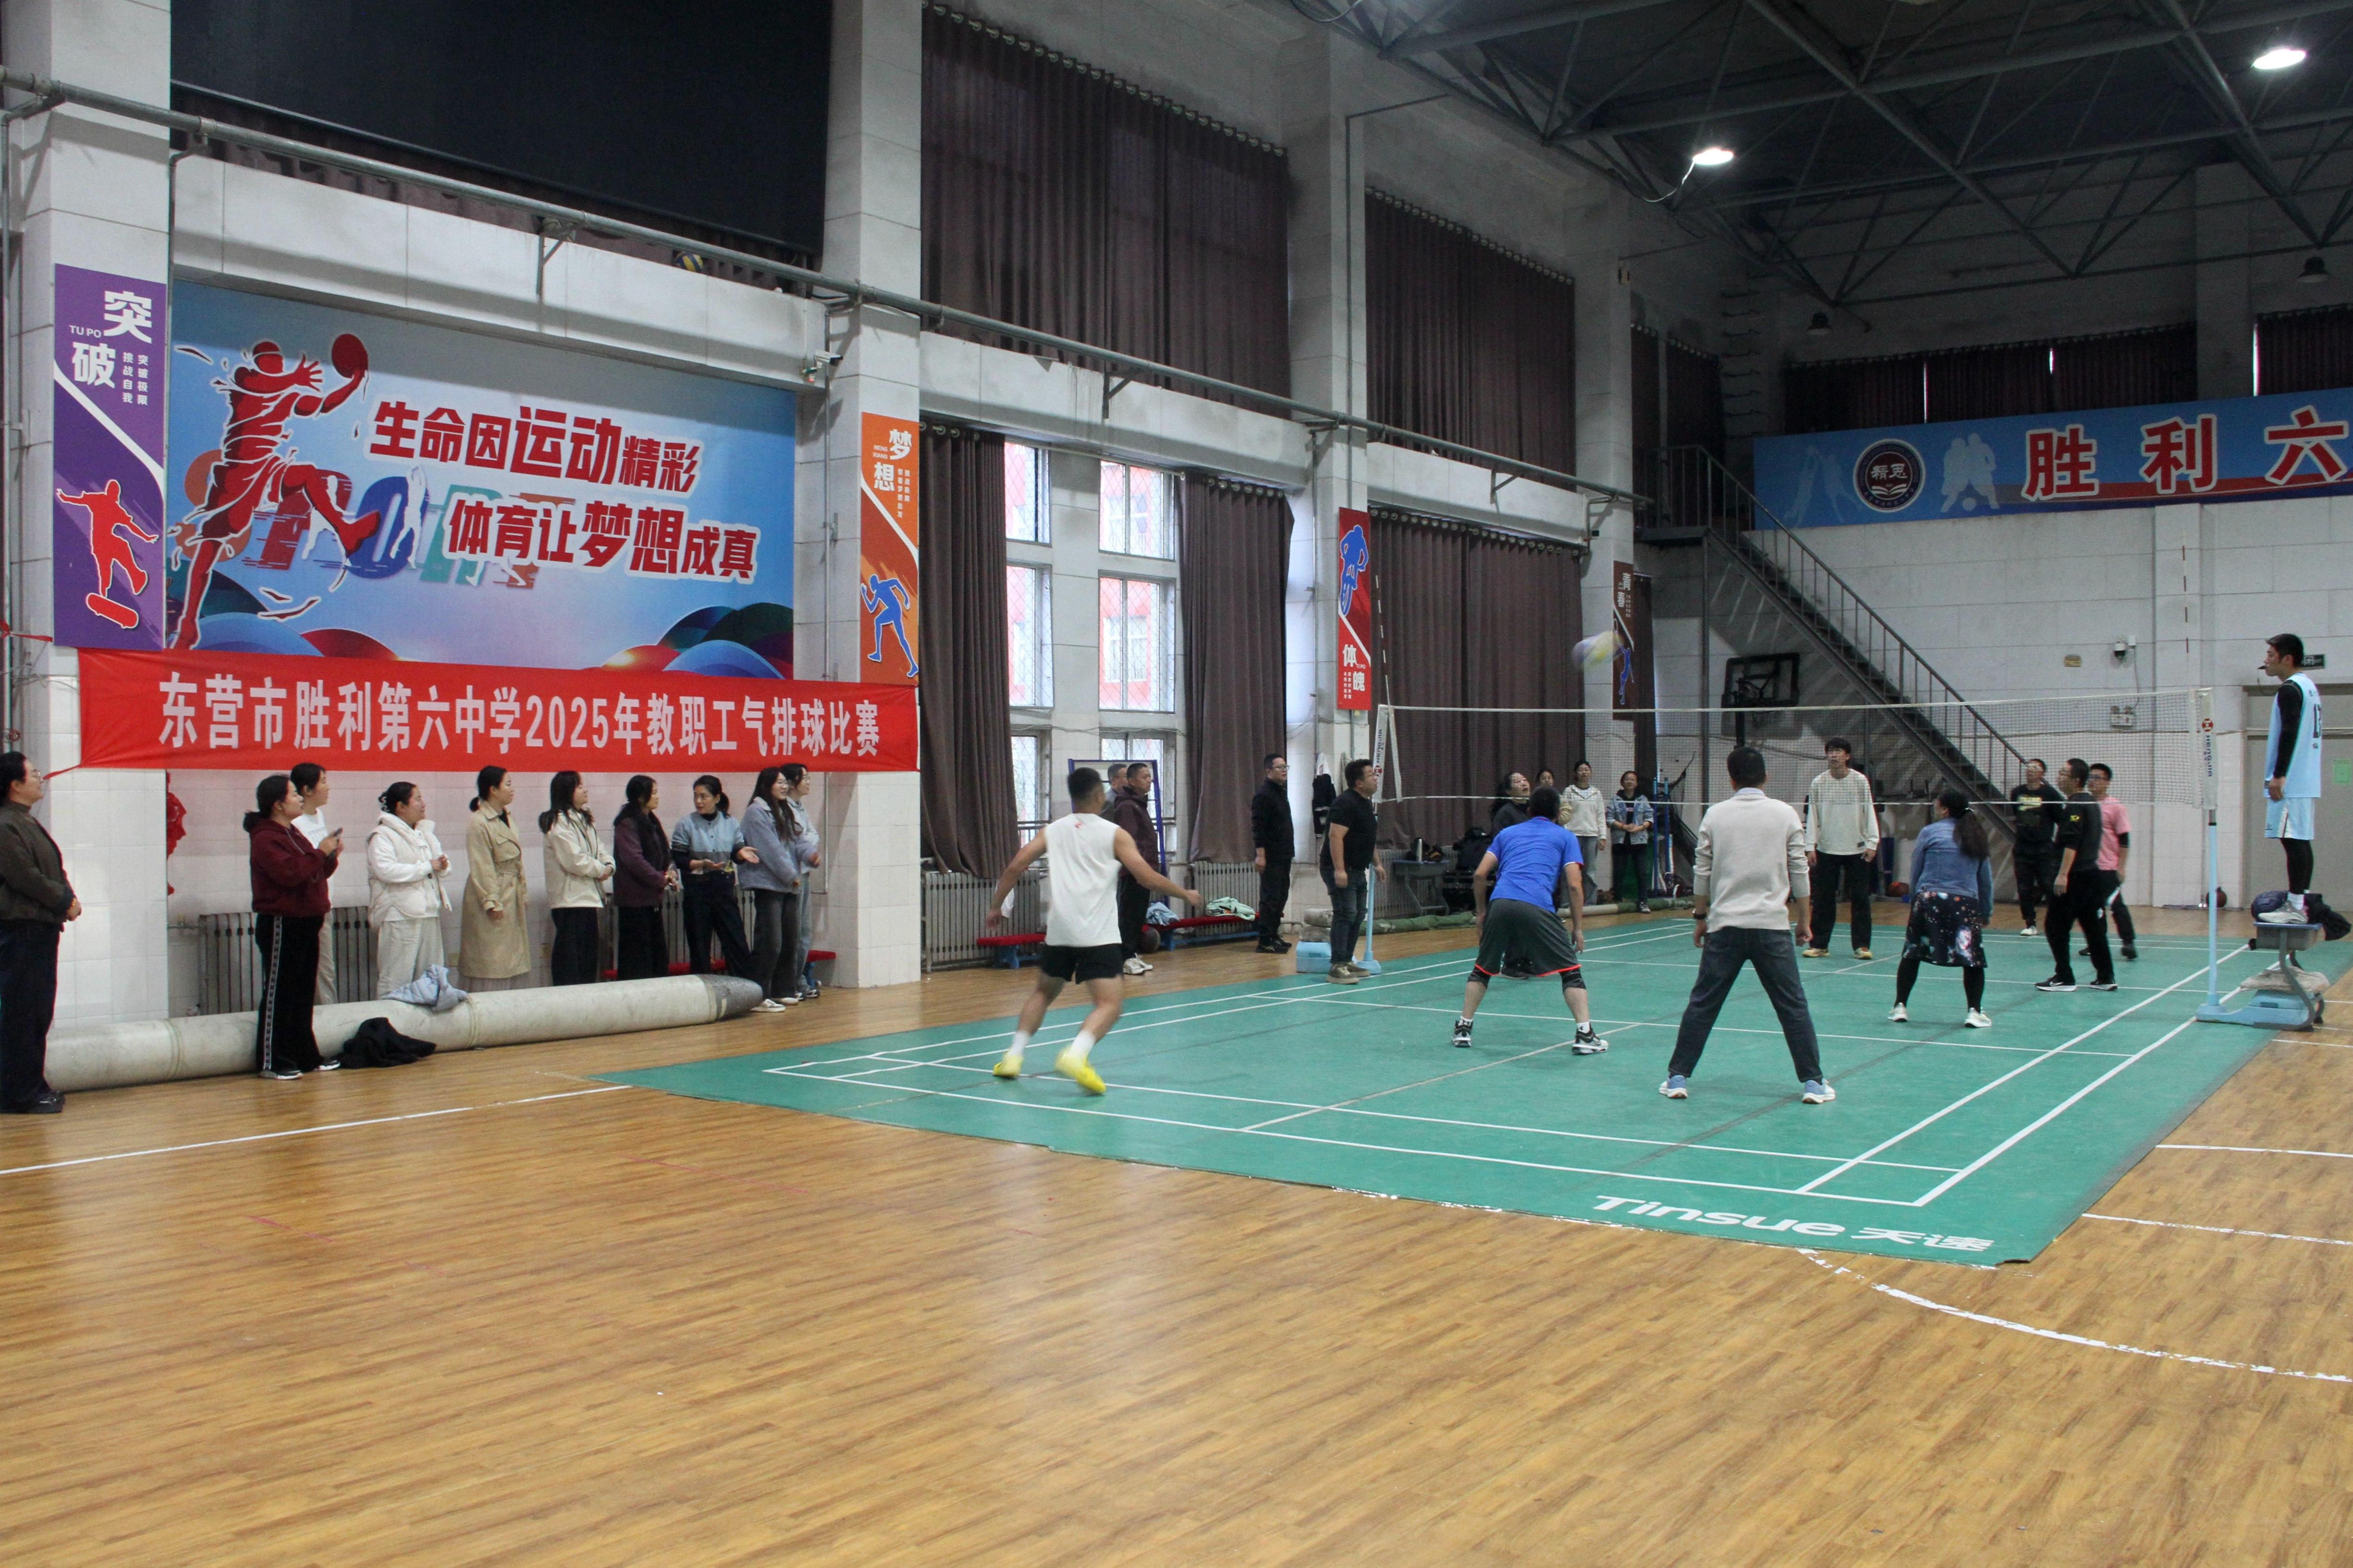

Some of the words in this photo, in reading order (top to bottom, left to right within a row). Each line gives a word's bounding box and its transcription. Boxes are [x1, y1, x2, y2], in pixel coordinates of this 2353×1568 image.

[69, 325, 84, 335] TU
[87, 328, 102, 338] PO
[103, 291, 152, 344] 突
[72, 342, 116, 389] 破
[123, 352, 133, 404] 挑战自我
[137, 354, 148, 406] 突破极限
[370, 401, 701, 493] 生命因运动精彩
[889, 429, 912, 460] 梦
[2025, 408, 2348, 498] 胜利六
[874, 462, 894, 491] 想
[448, 498, 758, 579] 体育让梦想成真
[1342, 644, 1357, 667] 体
[1353, 671, 1365, 691] 魄
[159, 671, 880, 756] 东营市胜利第六中学2025年教职工气排球比赛
[1593, 1195, 1846, 1236] Tinsue
[1850, 1227, 1995, 1252] 天速
